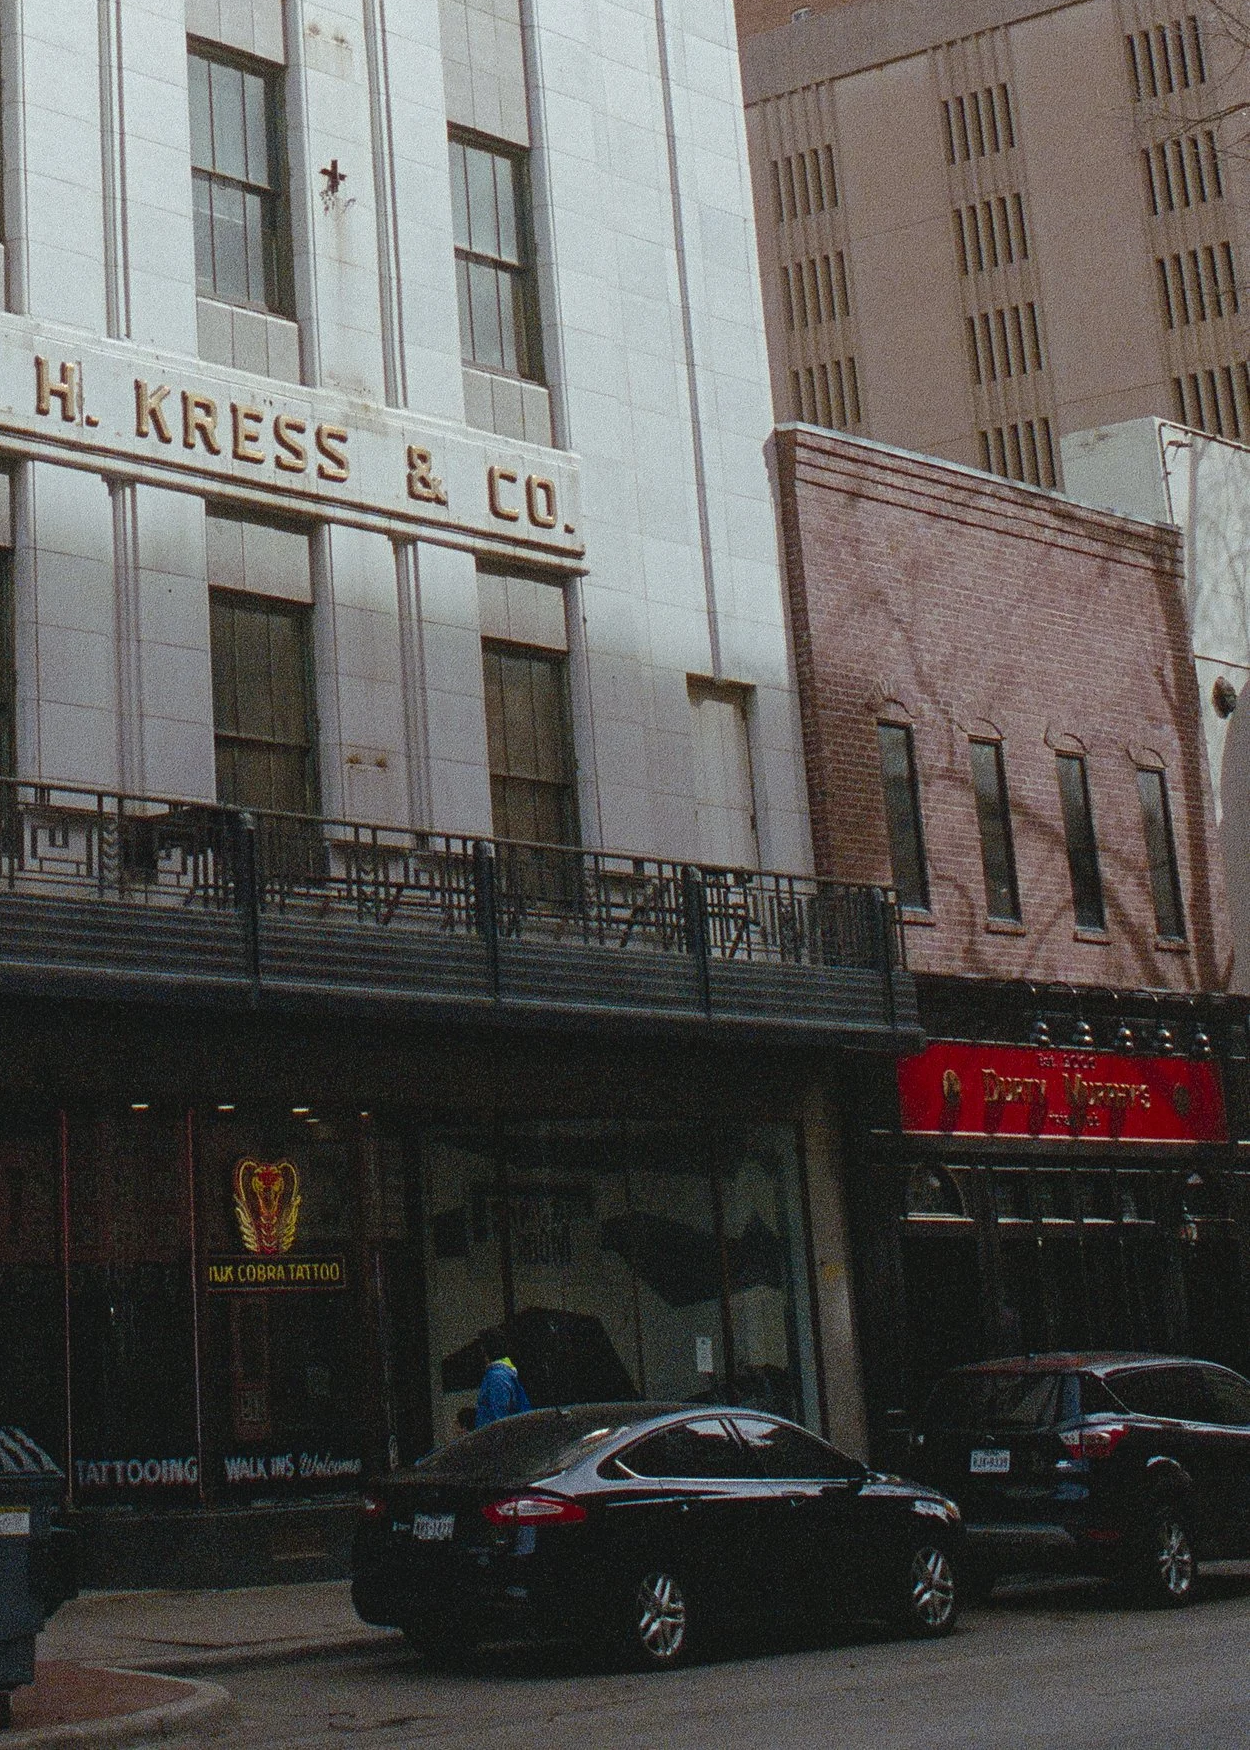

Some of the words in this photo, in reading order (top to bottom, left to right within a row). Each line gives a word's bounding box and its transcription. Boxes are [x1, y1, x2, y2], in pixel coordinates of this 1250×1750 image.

[34, 354, 100, 427] H.
[134, 377, 350, 483] KRESS
[406, 444, 448, 507] &
[487, 464, 577, 533] CO.
[238, 1263, 285, 1283] COBRA
[288, 1262, 340, 1281] TATTOO
[75, 1456, 198, 1486] TATTOOING
[224, 1456, 268, 1482] WALK
